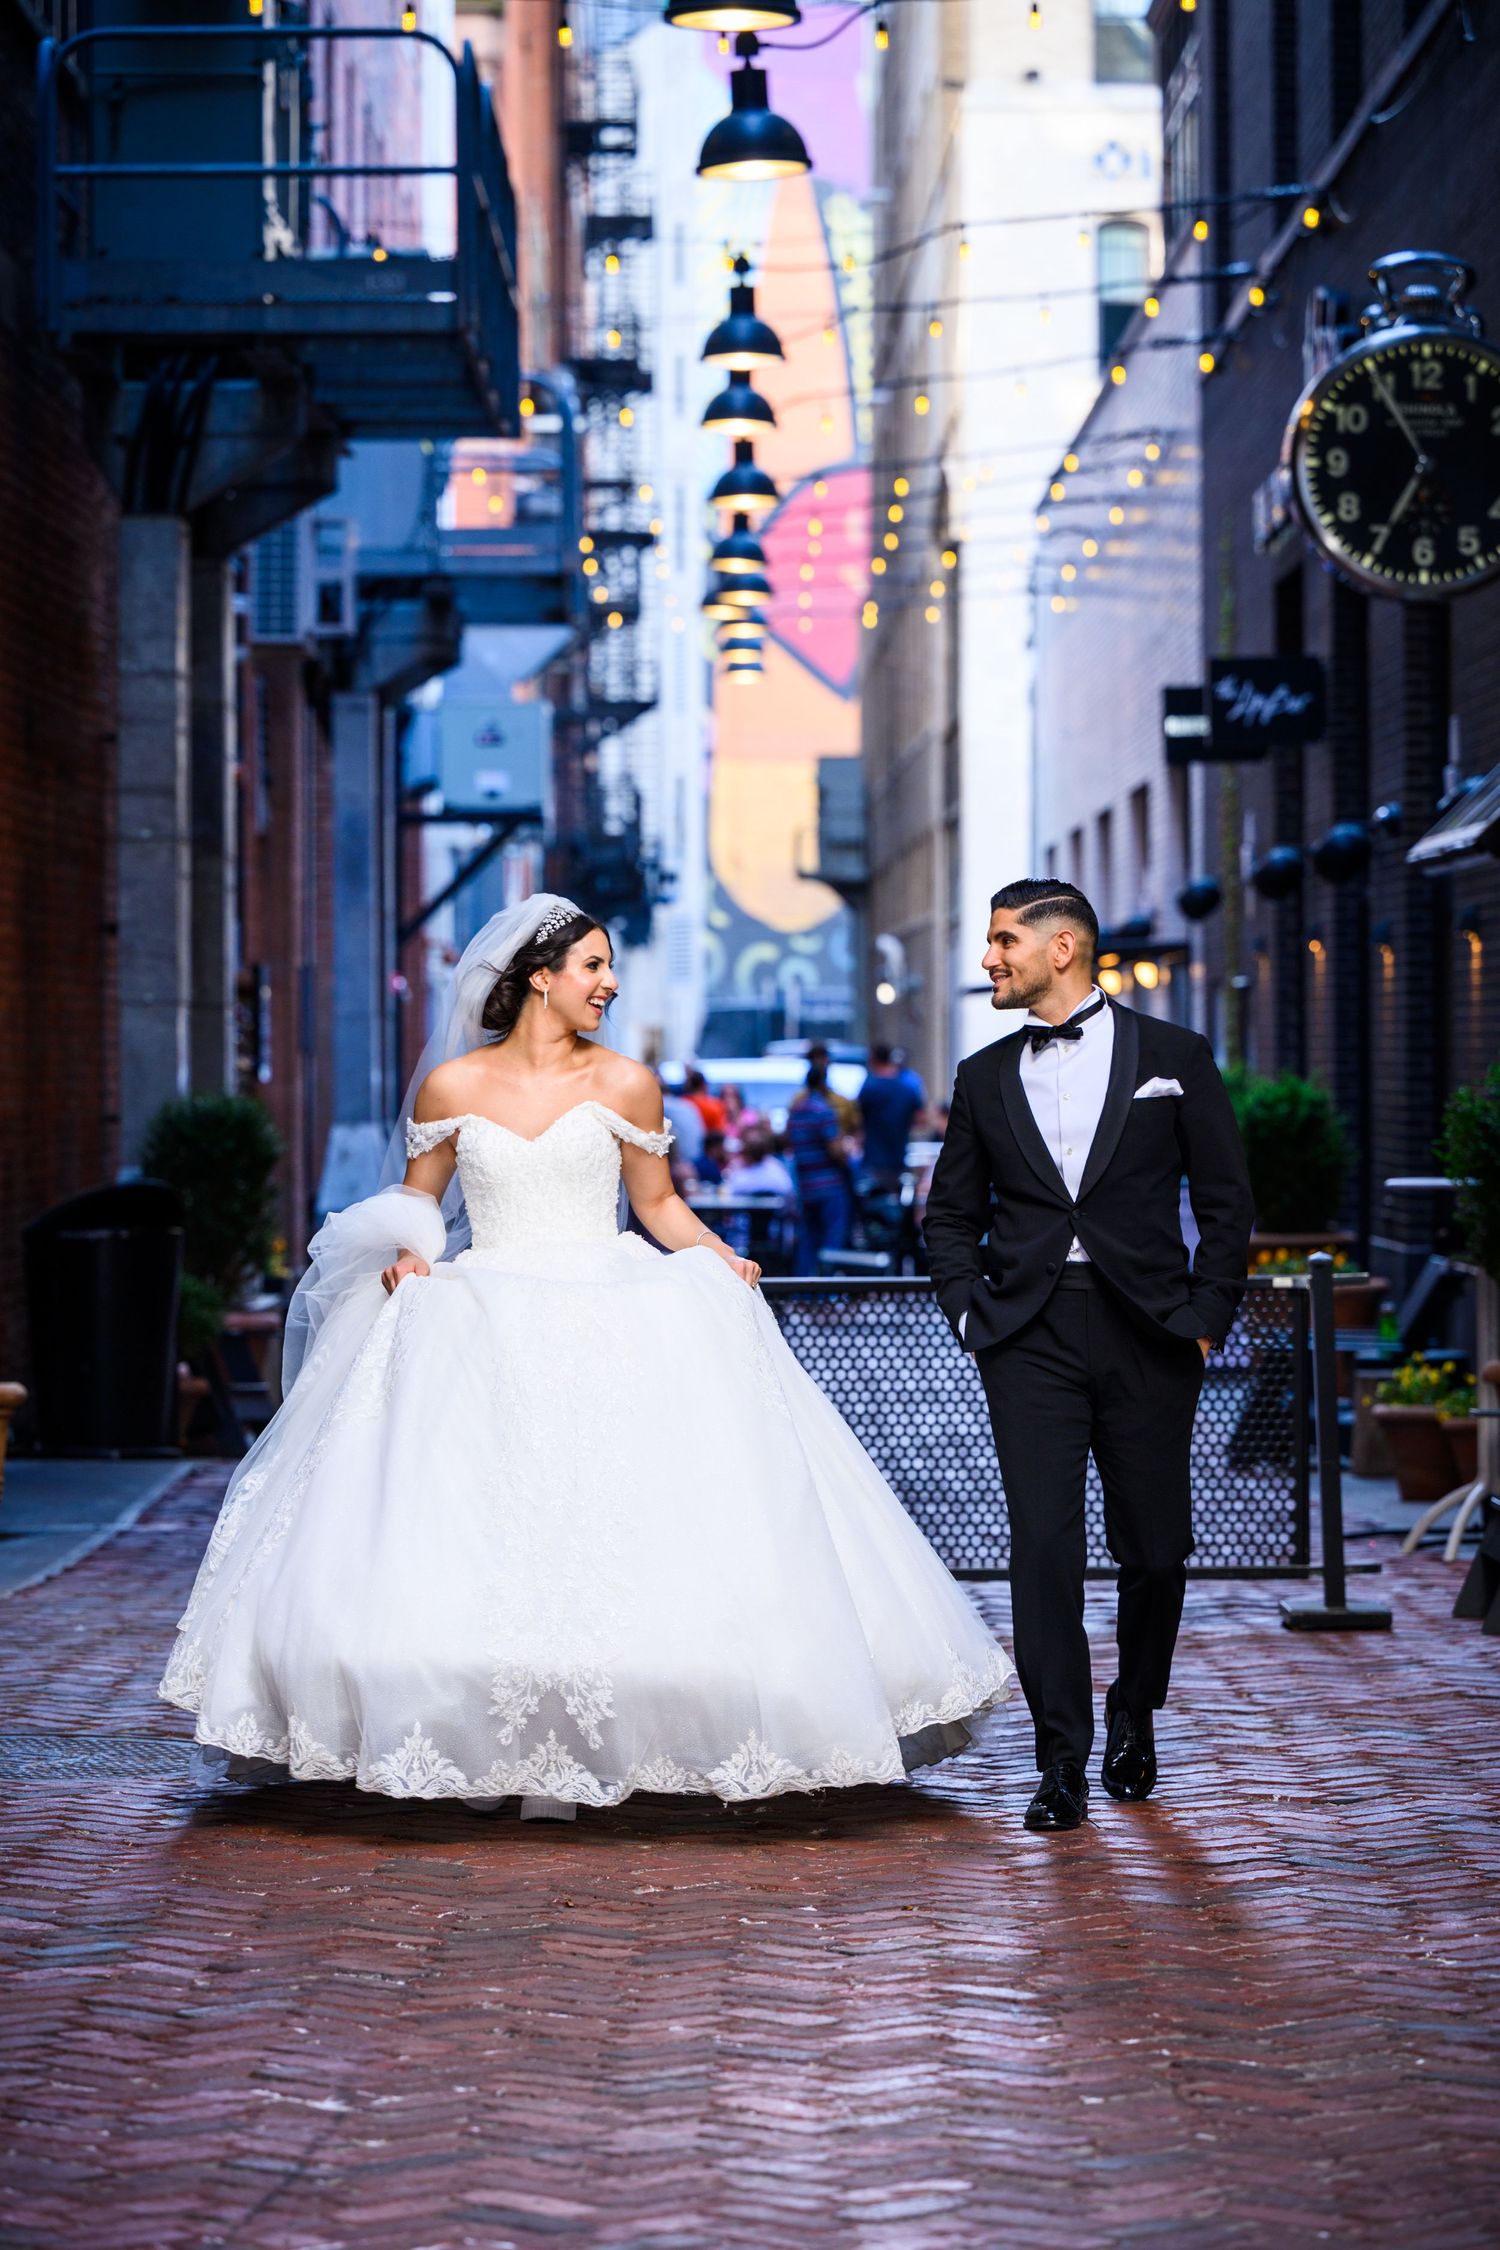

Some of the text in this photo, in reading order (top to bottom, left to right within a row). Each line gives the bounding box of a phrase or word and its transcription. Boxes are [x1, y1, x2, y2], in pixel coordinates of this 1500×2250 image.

[1409, 360, 1443, 390] 12
[1464, 373, 1477, 403] 1
[1335, 403, 1369, 434] 10
[1325, 447, 1349, 478] 9
[1337, 491, 1361, 523] 8
[1368, 523, 1391, 555] 7
[1412, 535, 1436, 567] 6
[1457, 525, 1480, 557] 5
